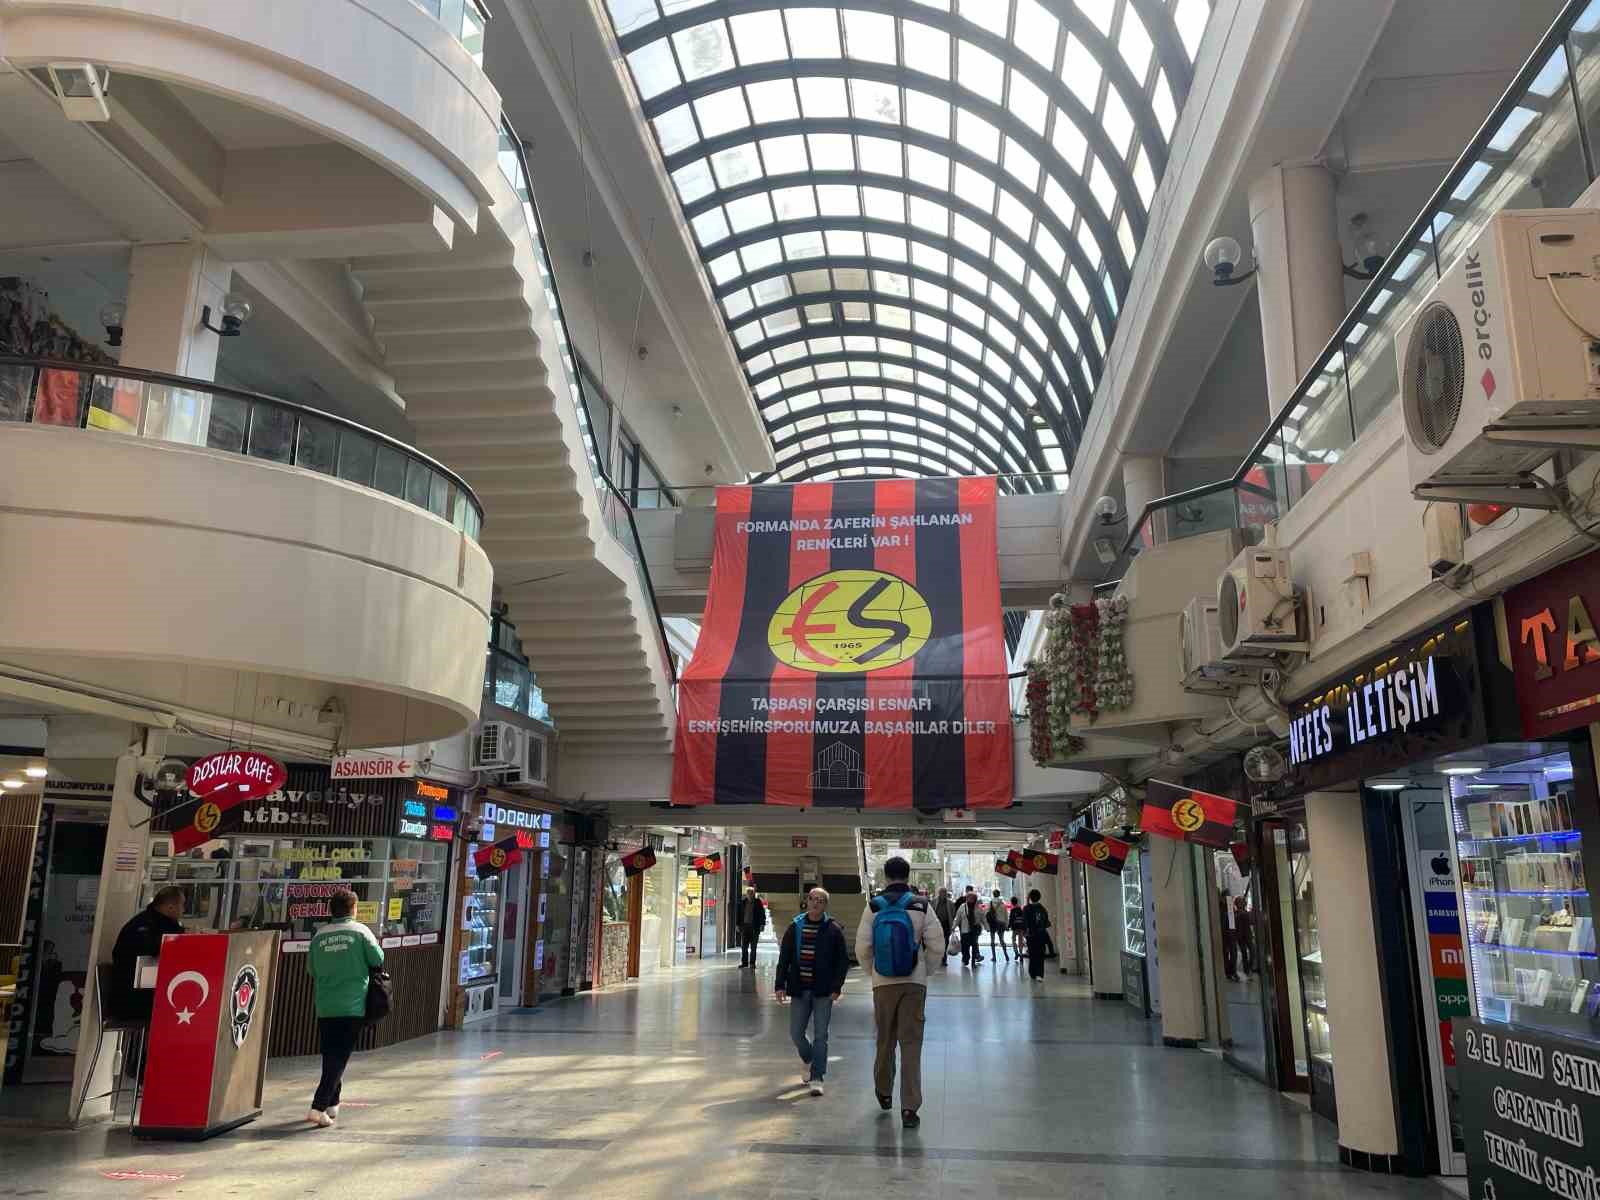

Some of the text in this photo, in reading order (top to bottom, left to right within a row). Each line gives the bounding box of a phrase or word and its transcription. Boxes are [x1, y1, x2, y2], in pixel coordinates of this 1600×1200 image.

[1464, 251, 1492, 361] arçelik
[736, 512, 973, 534] FORMANDA ZAFERİN ŞAHLANAN
[796, 535, 910, 552] RENKLERİ VAR !
[832, 641, 863, 650] 1965
[751, 696, 932, 713] TAŞBAŞI ÇARŞISI ESNAFI
[1288, 655, 1440, 766] NEFES İLETİŞİM
[687, 716, 996, 736] ESKİŞEHİRSPORUMUZA BAŞARILAR DİLER
[192, 752, 274, 786] DOSTLAR CAFE
[334, 758, 394, 777] ASANSÖR
[266, 787, 384, 809] avetiye
[243, 806, 330, 825] tbaa
[496, 807, 542, 830] DORUK
[1429, 877, 1456, 887] iPhon
[1438, 994, 1469, 1006] opp
[1465, 1029, 1481, 1060] 2.
[1481, 1034, 1501, 1067] EL
[1504, 1038, 1545, 1080] ALIM
[1493, 1085, 1584, 1147] GARANTİLİ
[1483, 1130, 1542, 1185] TEKNİK
